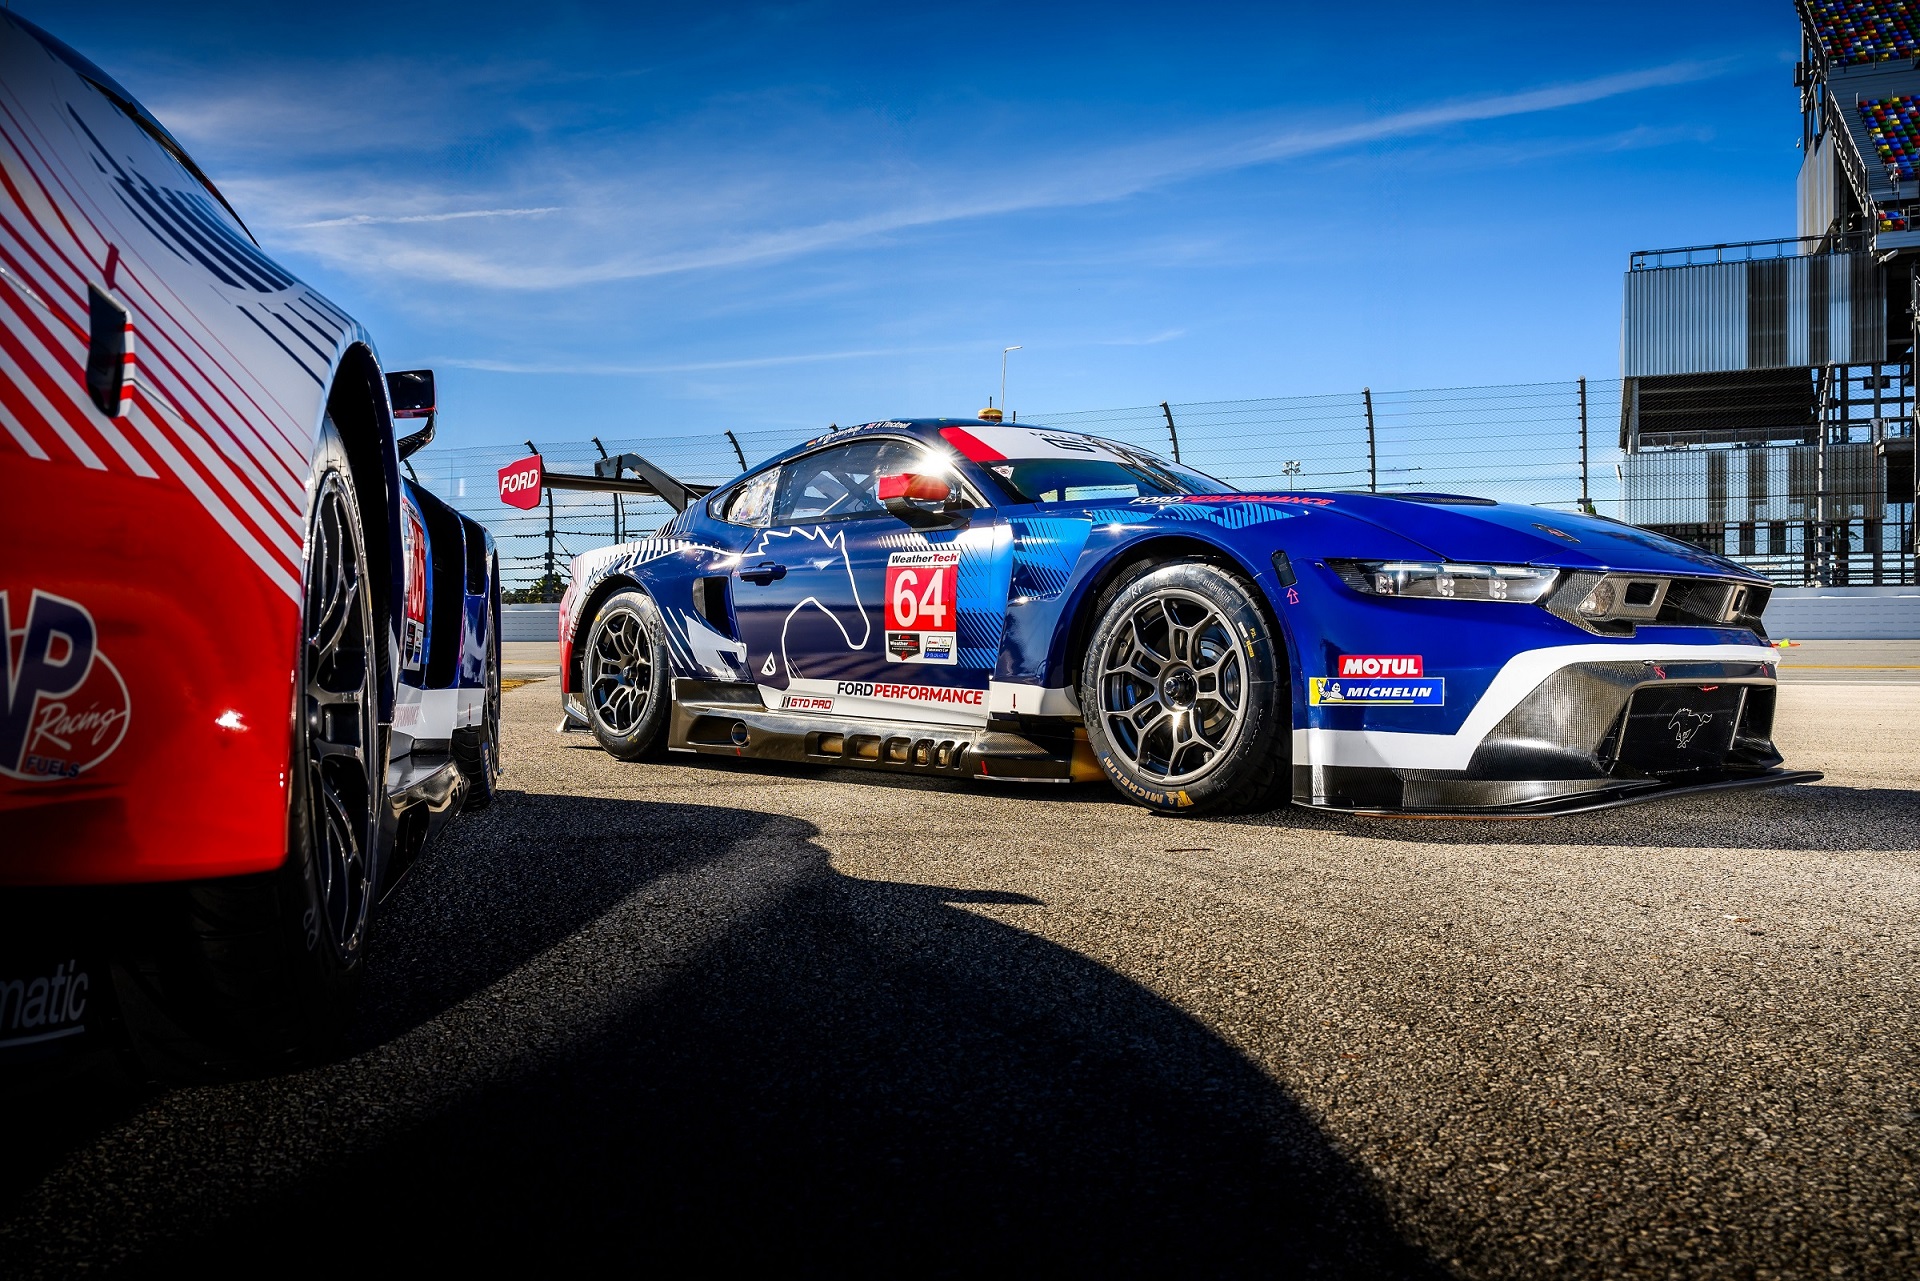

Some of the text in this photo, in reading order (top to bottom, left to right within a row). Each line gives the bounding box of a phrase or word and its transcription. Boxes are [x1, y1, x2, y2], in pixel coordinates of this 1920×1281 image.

[500, 469, 539, 495] FORD
[892, 553, 960, 564] WeatherTech
[893, 568, 947, 628] 64
[1342, 658, 1419, 675] MOTUL
[790, 698, 832, 709] GTD PRO
[1346, 687, 1432, 697] MICHELIN
[30, 701, 118, 752] Racing
[24, 756, 80, 779] FUELS
[1103, 756, 1164, 804] MICHELIN
